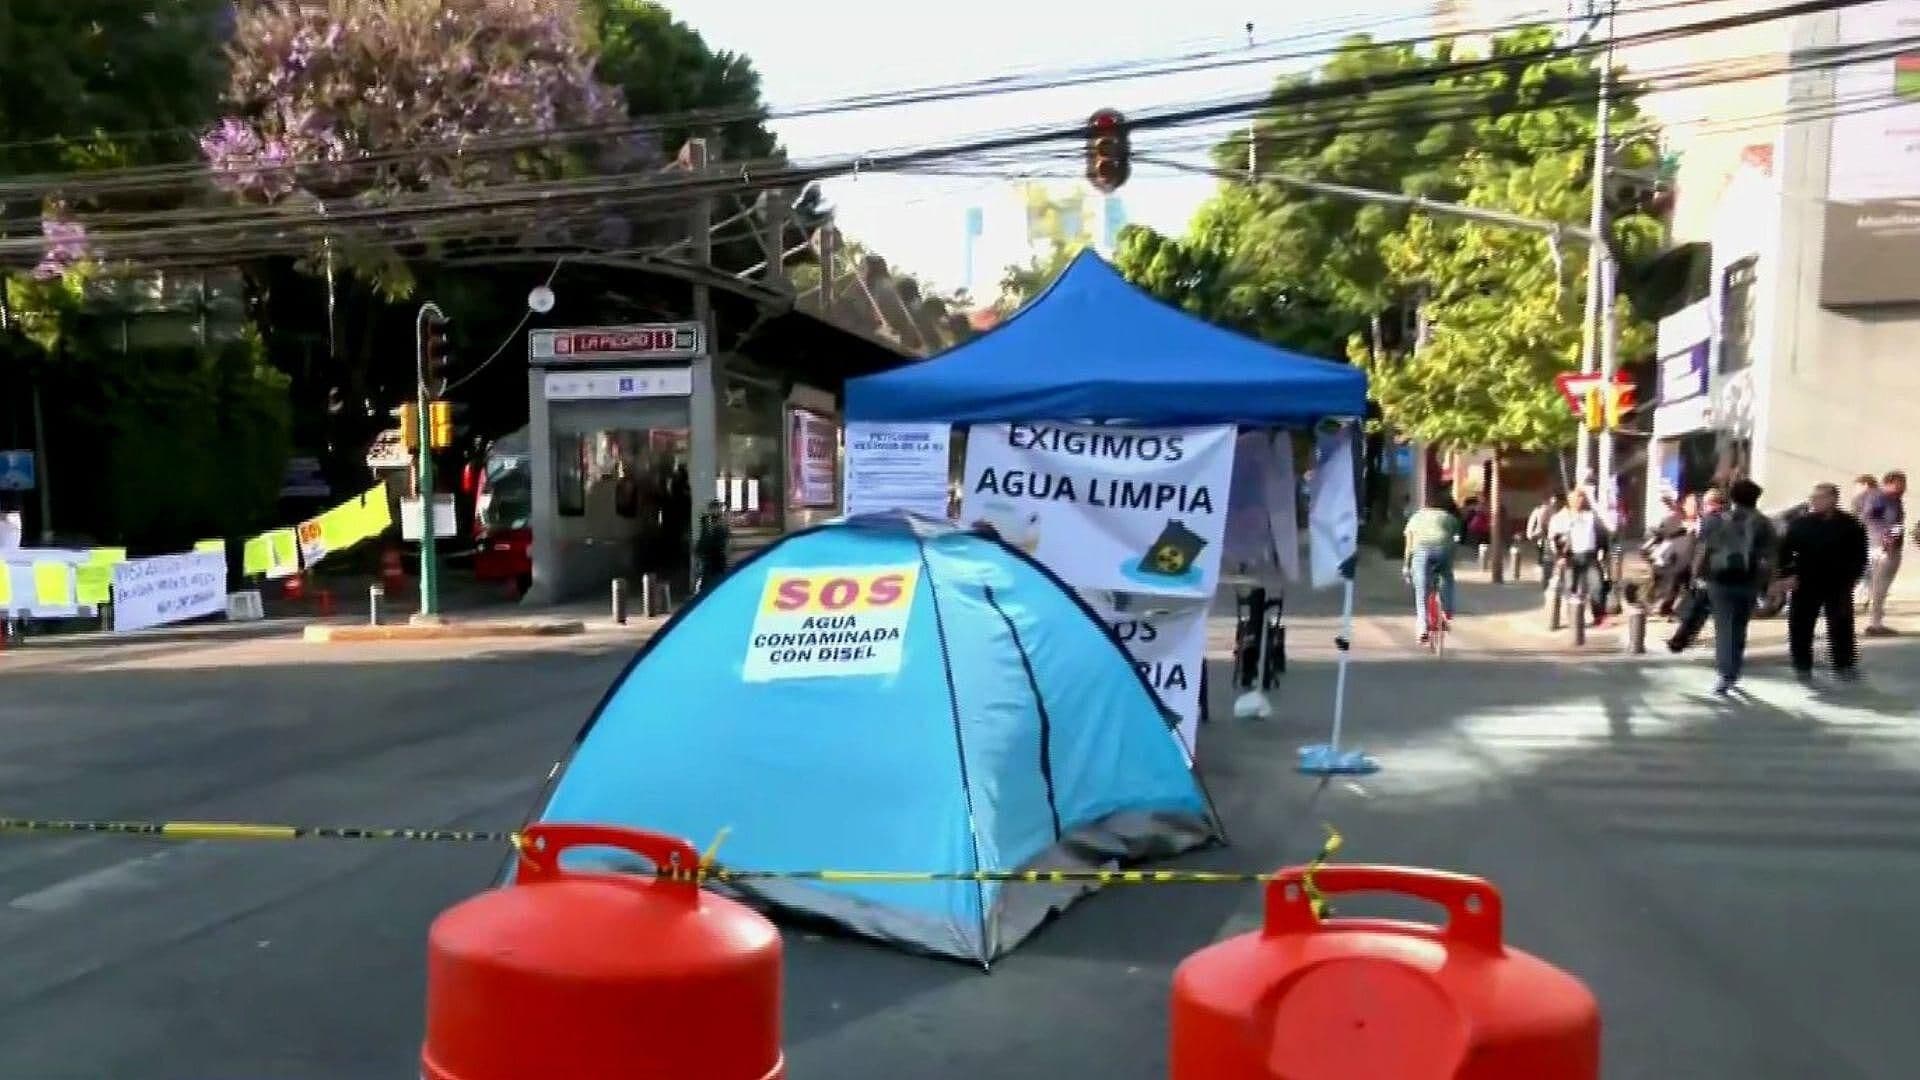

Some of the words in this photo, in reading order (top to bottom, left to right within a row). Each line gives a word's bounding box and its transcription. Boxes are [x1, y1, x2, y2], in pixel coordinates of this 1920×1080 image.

[1008, 423, 1184, 461] EXIGIMOS
[975, 467, 1077, 502] AGUA
[1088, 478, 1214, 514] LIMPIA
[774, 574, 905, 611] SOS
[802, 615, 857, 630] AGUA
[754, 627, 900, 649] CONTAMINADA
[769, 648, 812, 665] CON
[818, 646, 877, 663] DISEL
